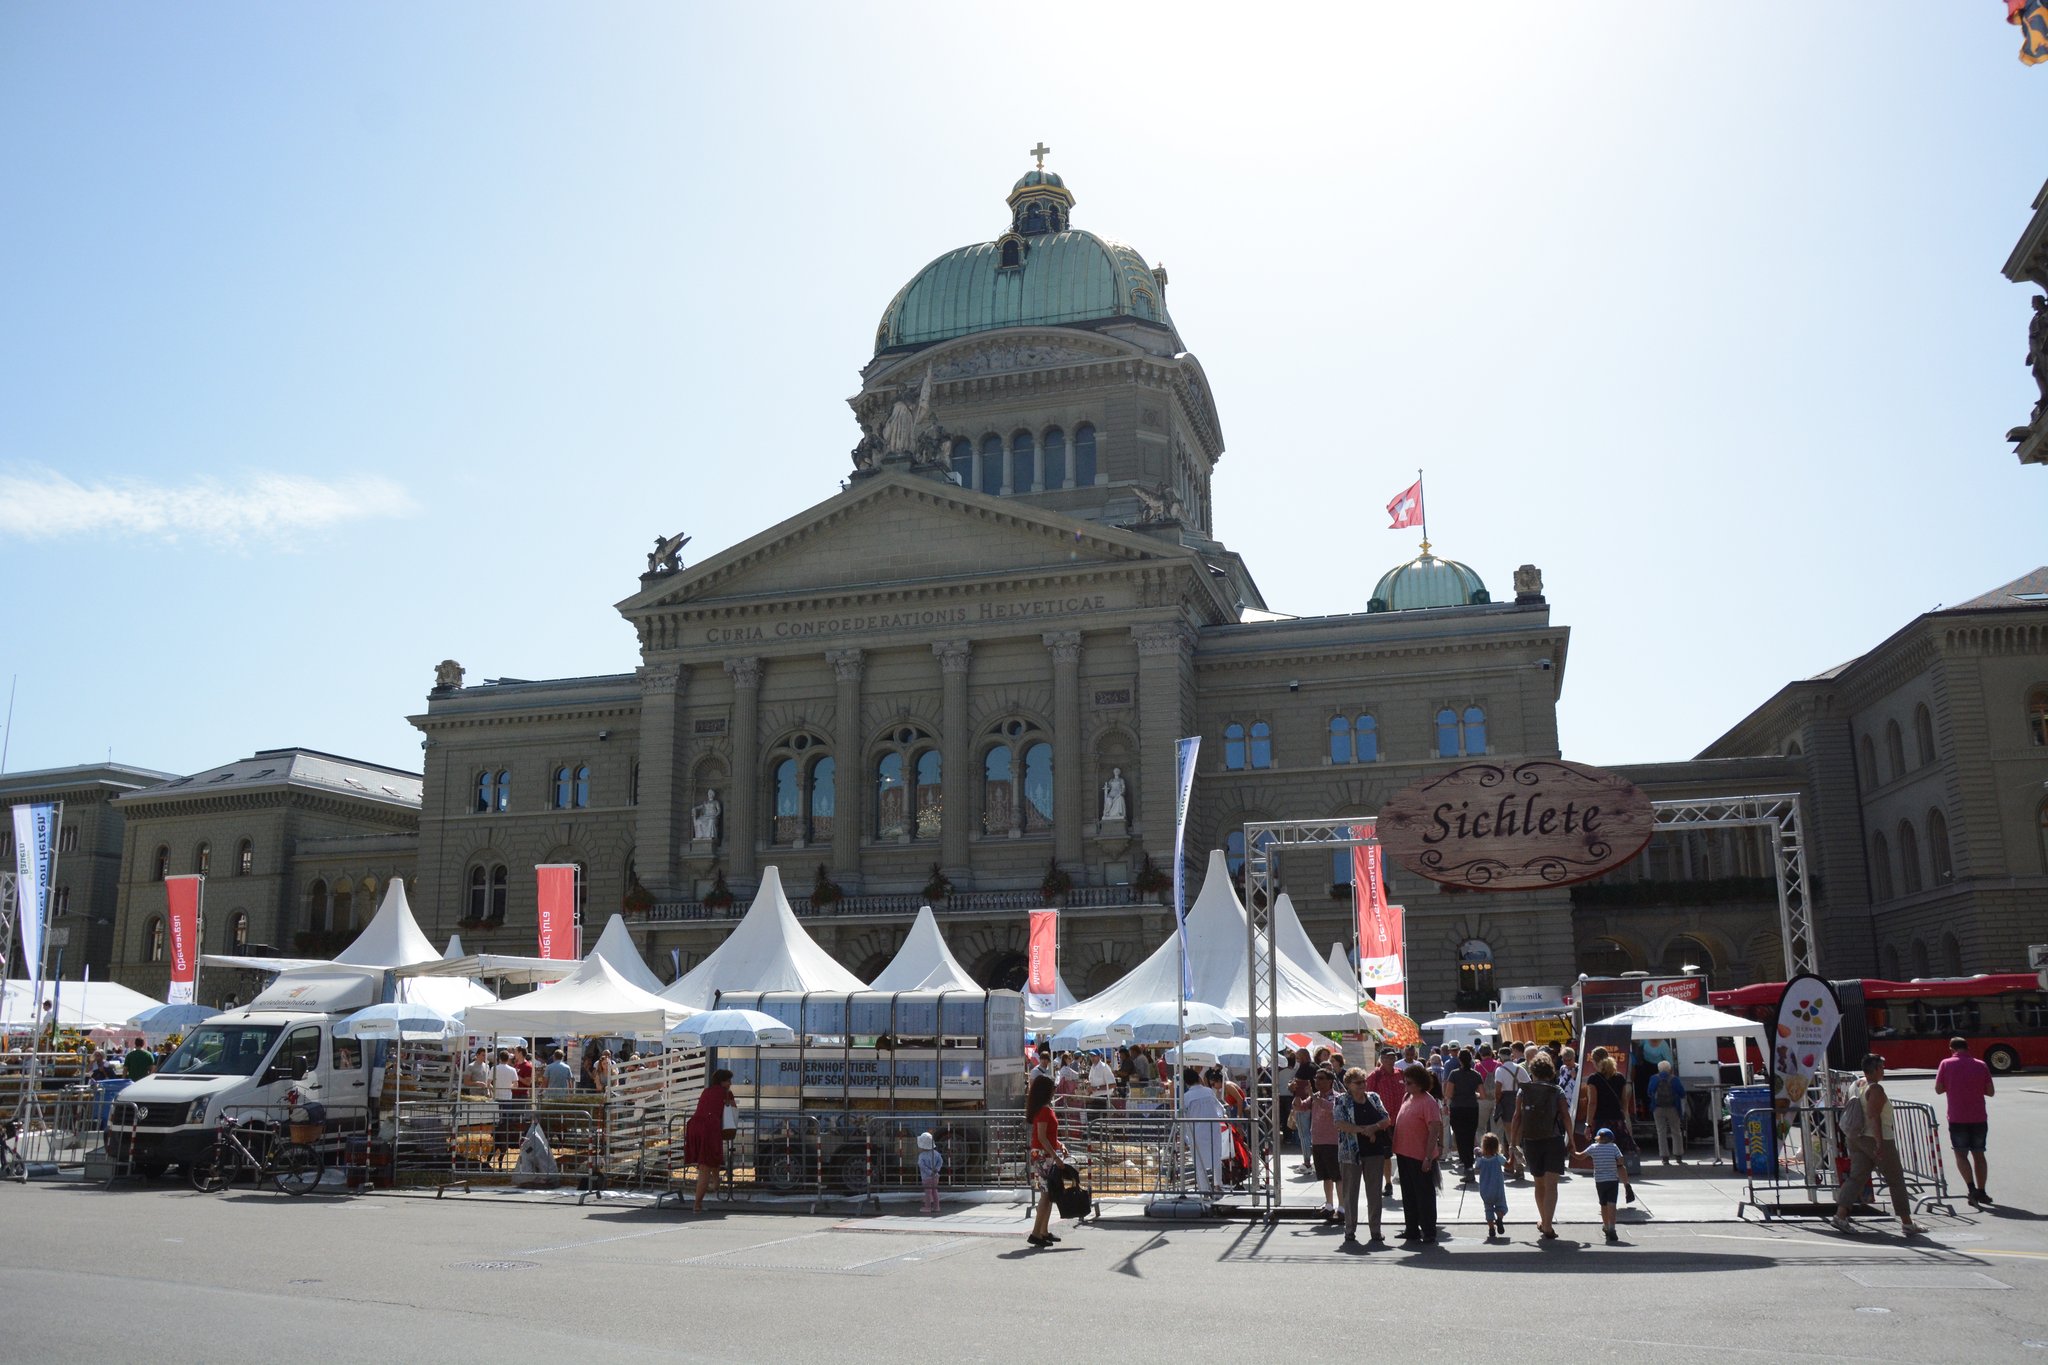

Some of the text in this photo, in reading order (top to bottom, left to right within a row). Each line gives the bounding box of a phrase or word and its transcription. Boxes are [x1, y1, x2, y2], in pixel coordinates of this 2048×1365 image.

[706, 595, 1105, 643] CURIA CONFOEDERATIONIS HELVETICAE
[1422, 793, 1602, 844] Sichlete
[1660, 981, 1697, 996] Schweizer
[804, 1075, 824, 1085] AUF
